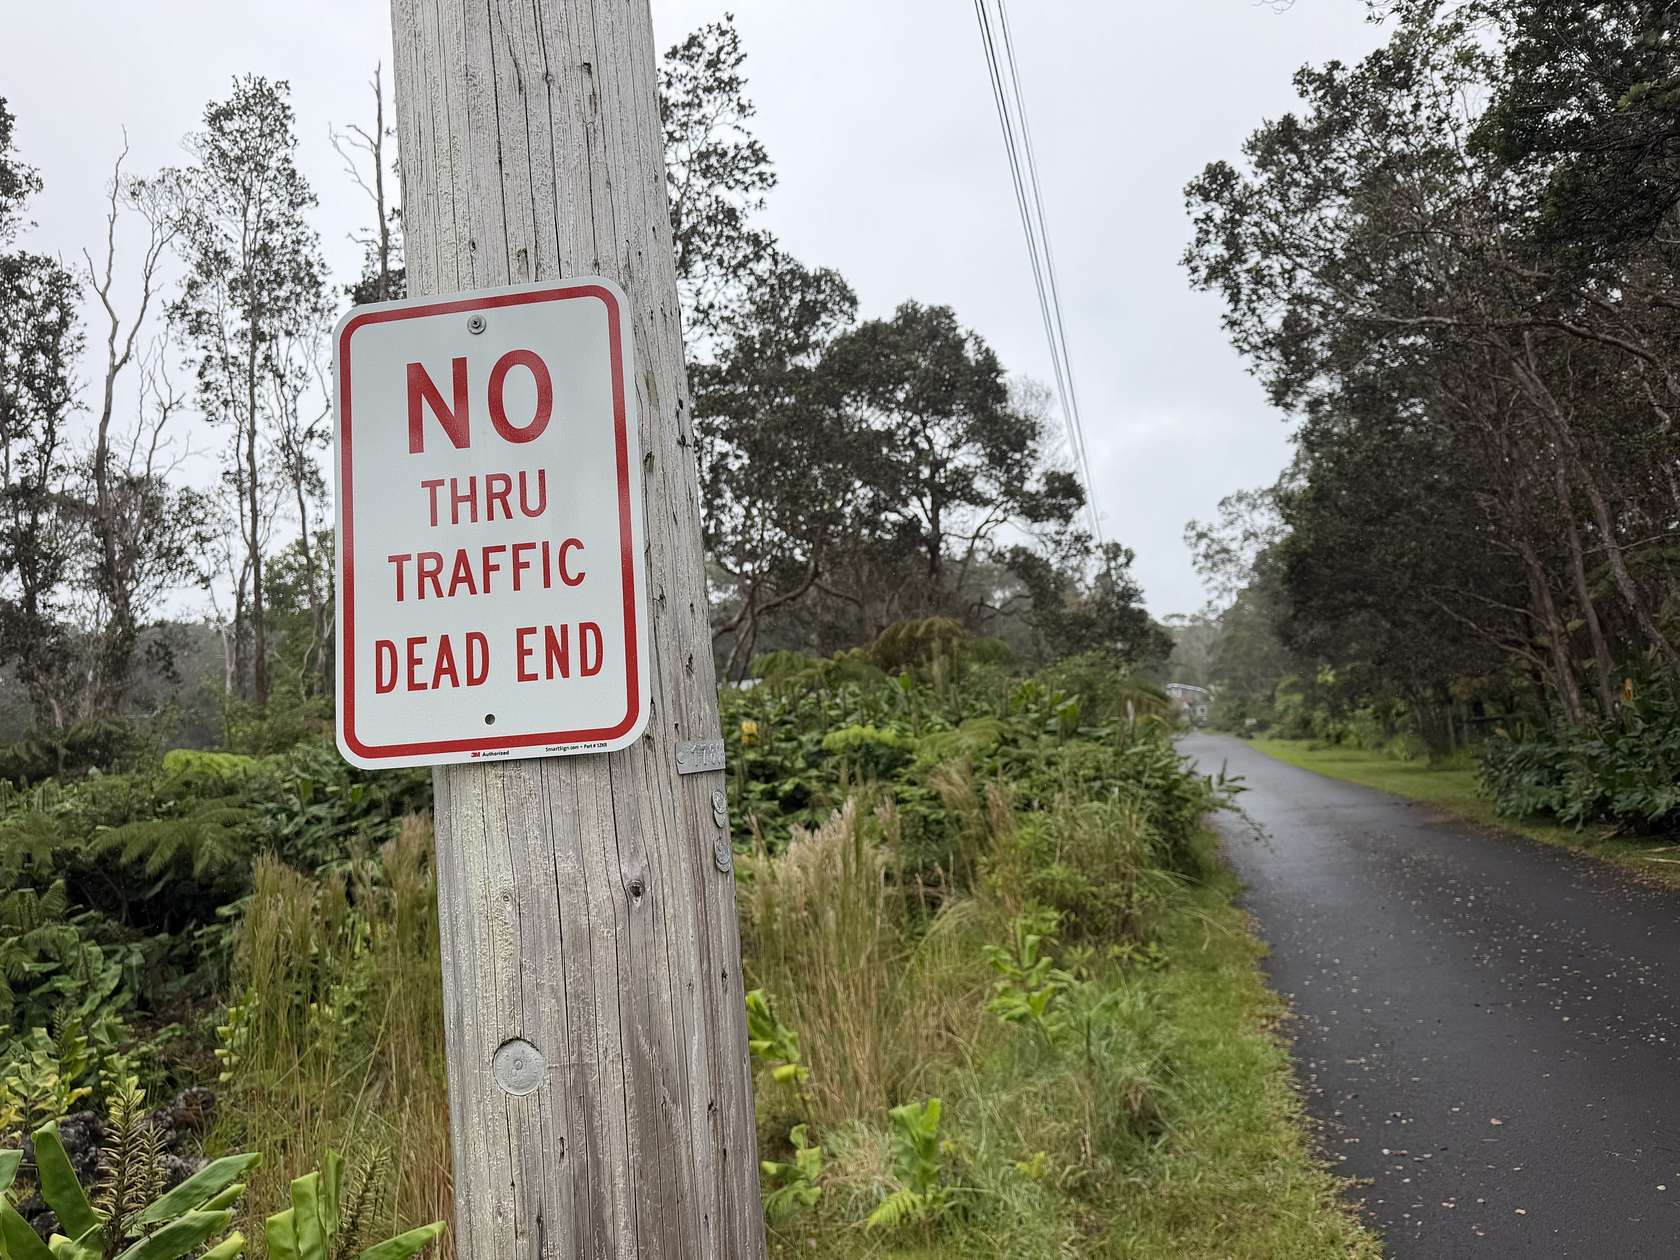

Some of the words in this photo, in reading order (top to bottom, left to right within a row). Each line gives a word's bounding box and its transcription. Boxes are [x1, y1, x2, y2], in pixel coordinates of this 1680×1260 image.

[407, 349, 553, 454] NO
[421, 469, 547, 527] THRU
[388, 538, 586, 602] TRAFFIC
[375, 631, 490, 694] DEAD
[516, 622, 603, 682] END
